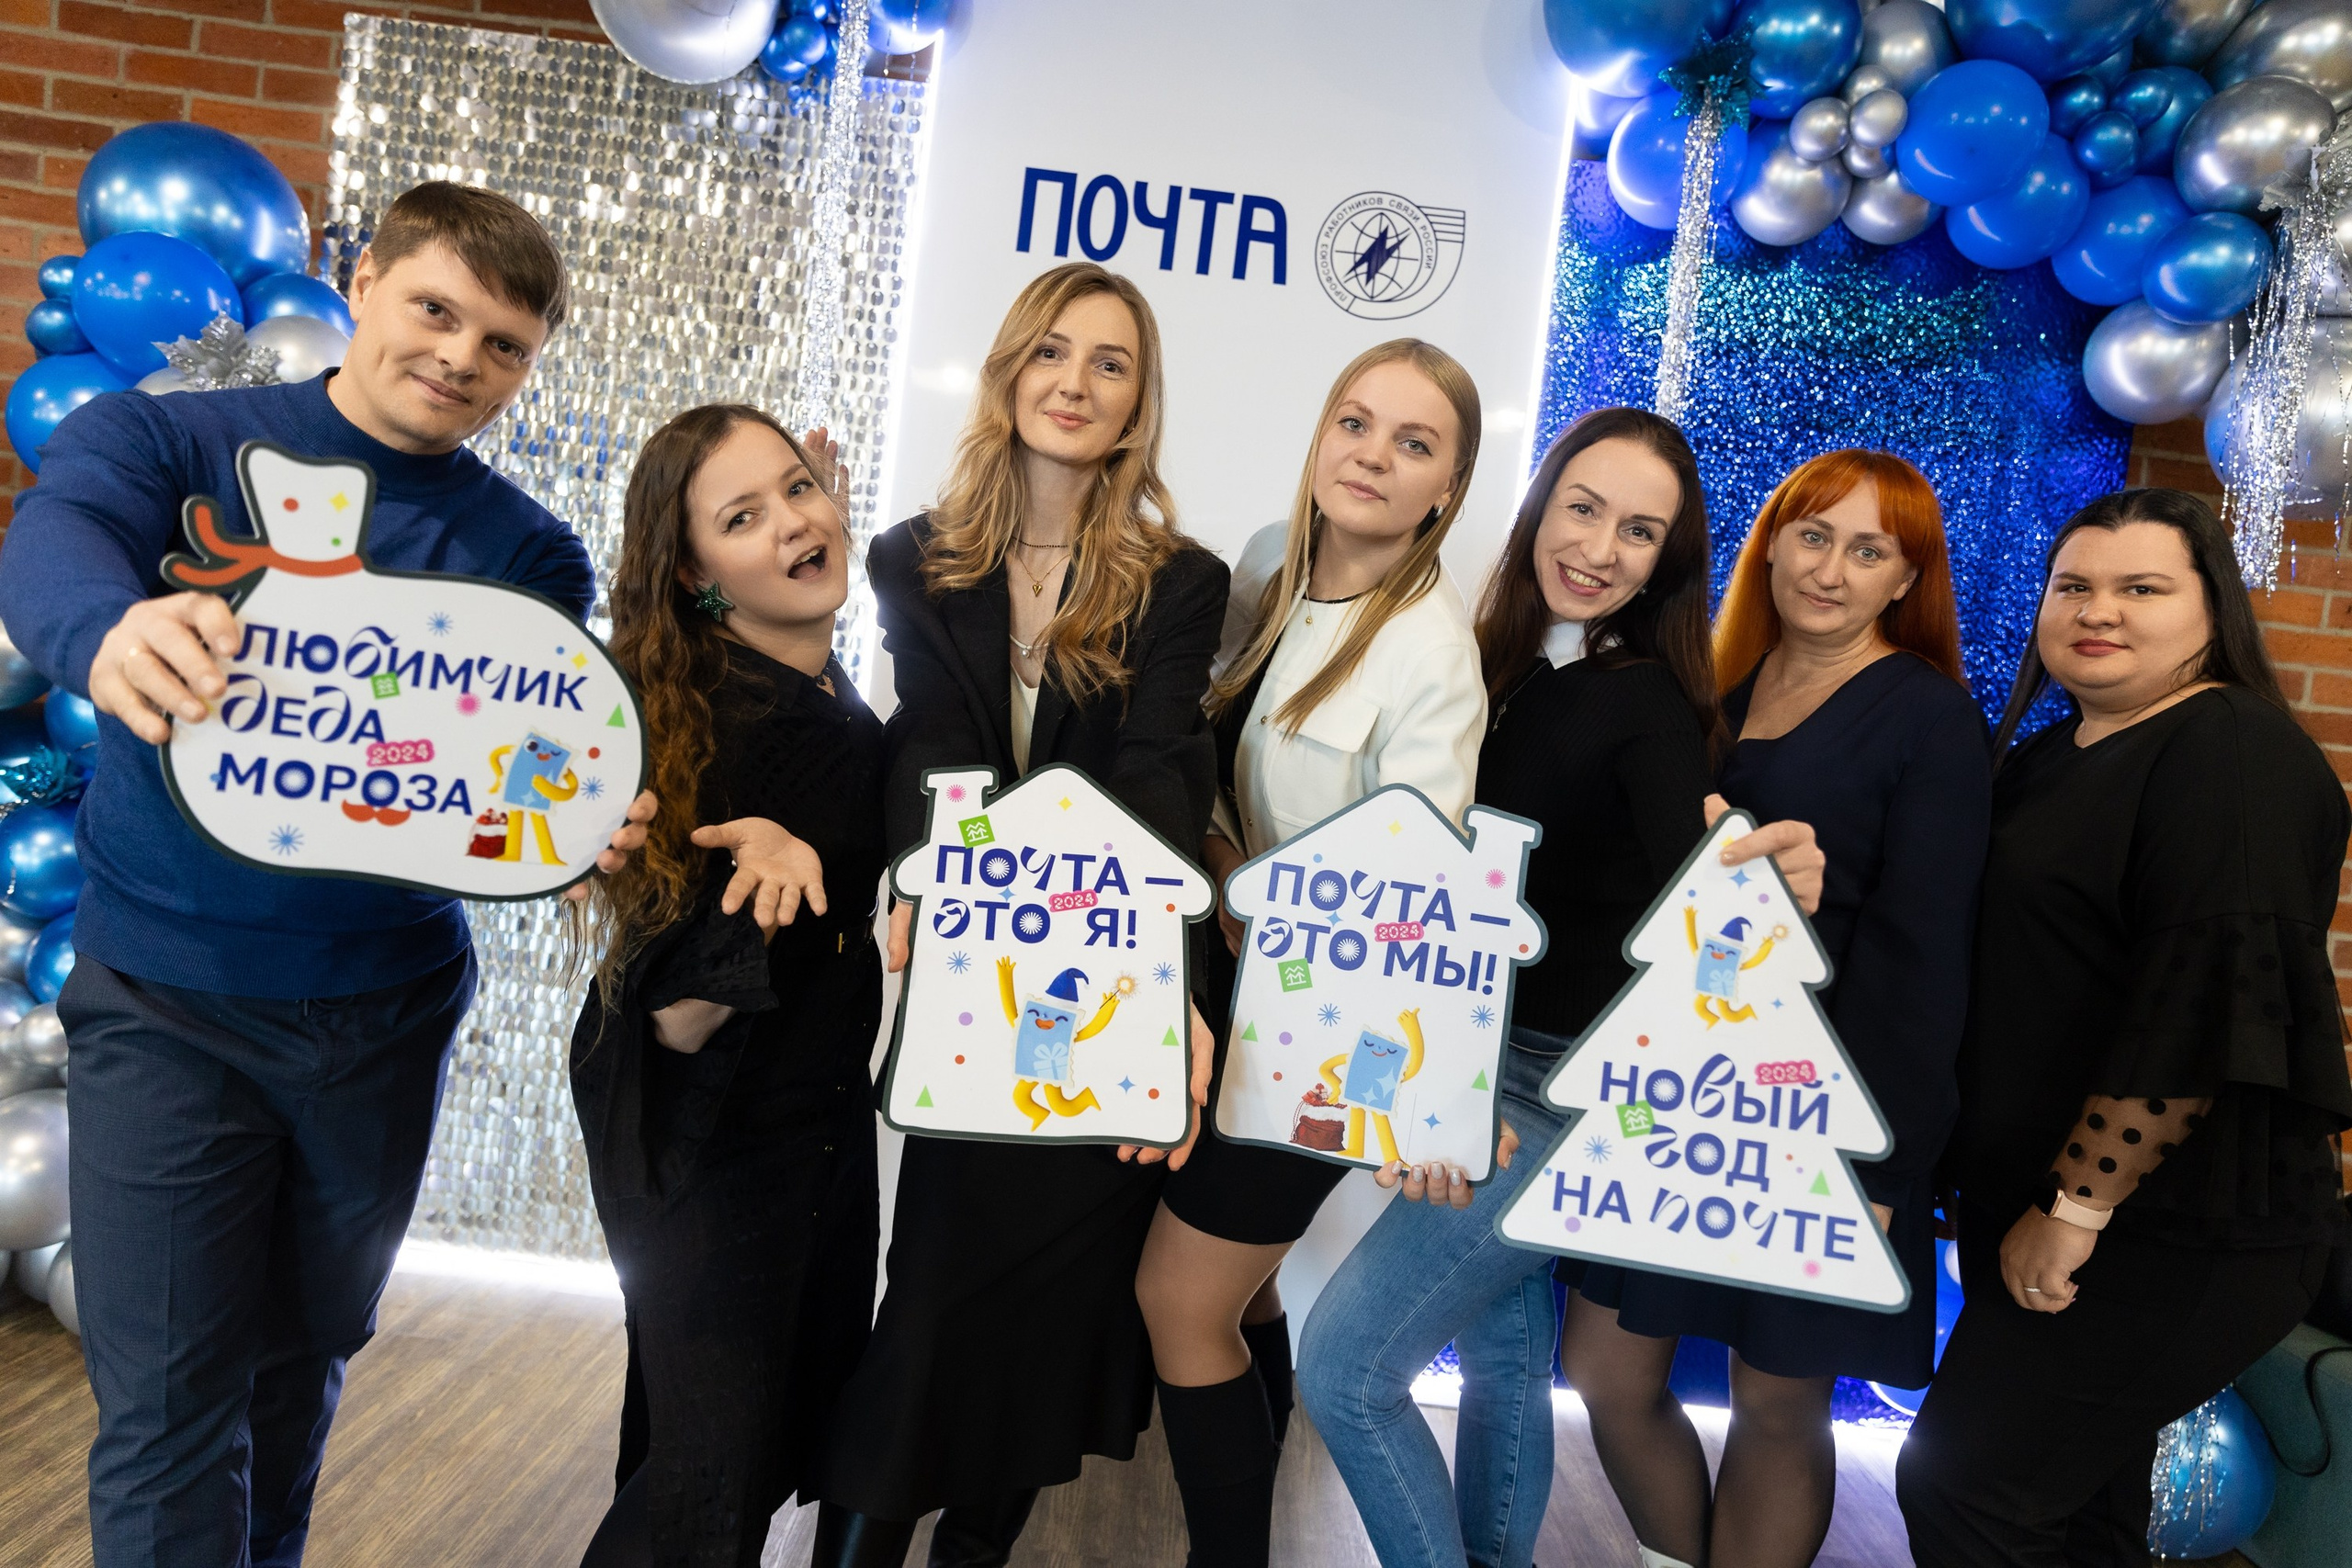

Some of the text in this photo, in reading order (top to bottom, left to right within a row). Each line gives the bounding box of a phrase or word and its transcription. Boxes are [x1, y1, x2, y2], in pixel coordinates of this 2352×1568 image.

[1016, 167, 1286, 285] ПОЧТА
[1320, 197, 1433, 302] ПРОФСОЮЗ РАБОТНИКОВ СВЯЗИ РОССИИ
[369, 741, 430, 766] 2024
[216, 752, 473, 817] МОРОЗА
[936, 844, 1130, 897] ПОЧТА
[1266, 861, 1456, 931] ПОЧТА
[933, 897, 1137, 950] ЭТО Я!
[1053, 892, 1095, 909] 2024
[1257, 916, 1498, 996] ЭТО МЫ!
[1377, 923, 1419, 940] 2024
[1758, 1064, 1813, 1084] 2024
[1552, 1170, 1632, 1224] НА
